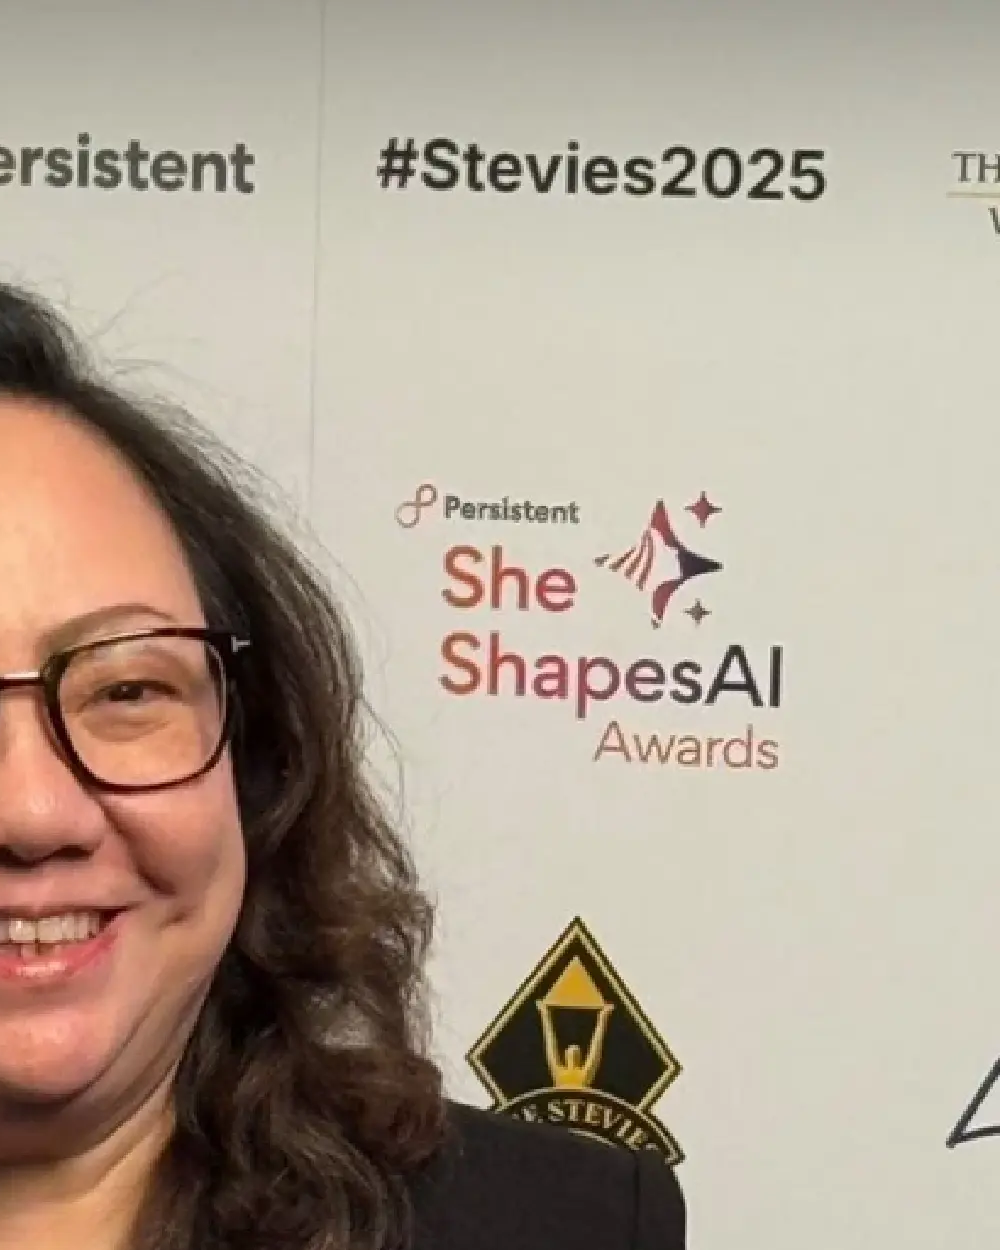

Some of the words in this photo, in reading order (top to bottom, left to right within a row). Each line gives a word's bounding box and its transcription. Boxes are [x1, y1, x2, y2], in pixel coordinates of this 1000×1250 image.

[377, 137, 827, 201] #Stevies2025
[443, 495, 581, 525] Persistent
[441, 545, 578, 612] She
[439, 630, 783, 720] ShapesAI
[592, 720, 780, 770] Awards
